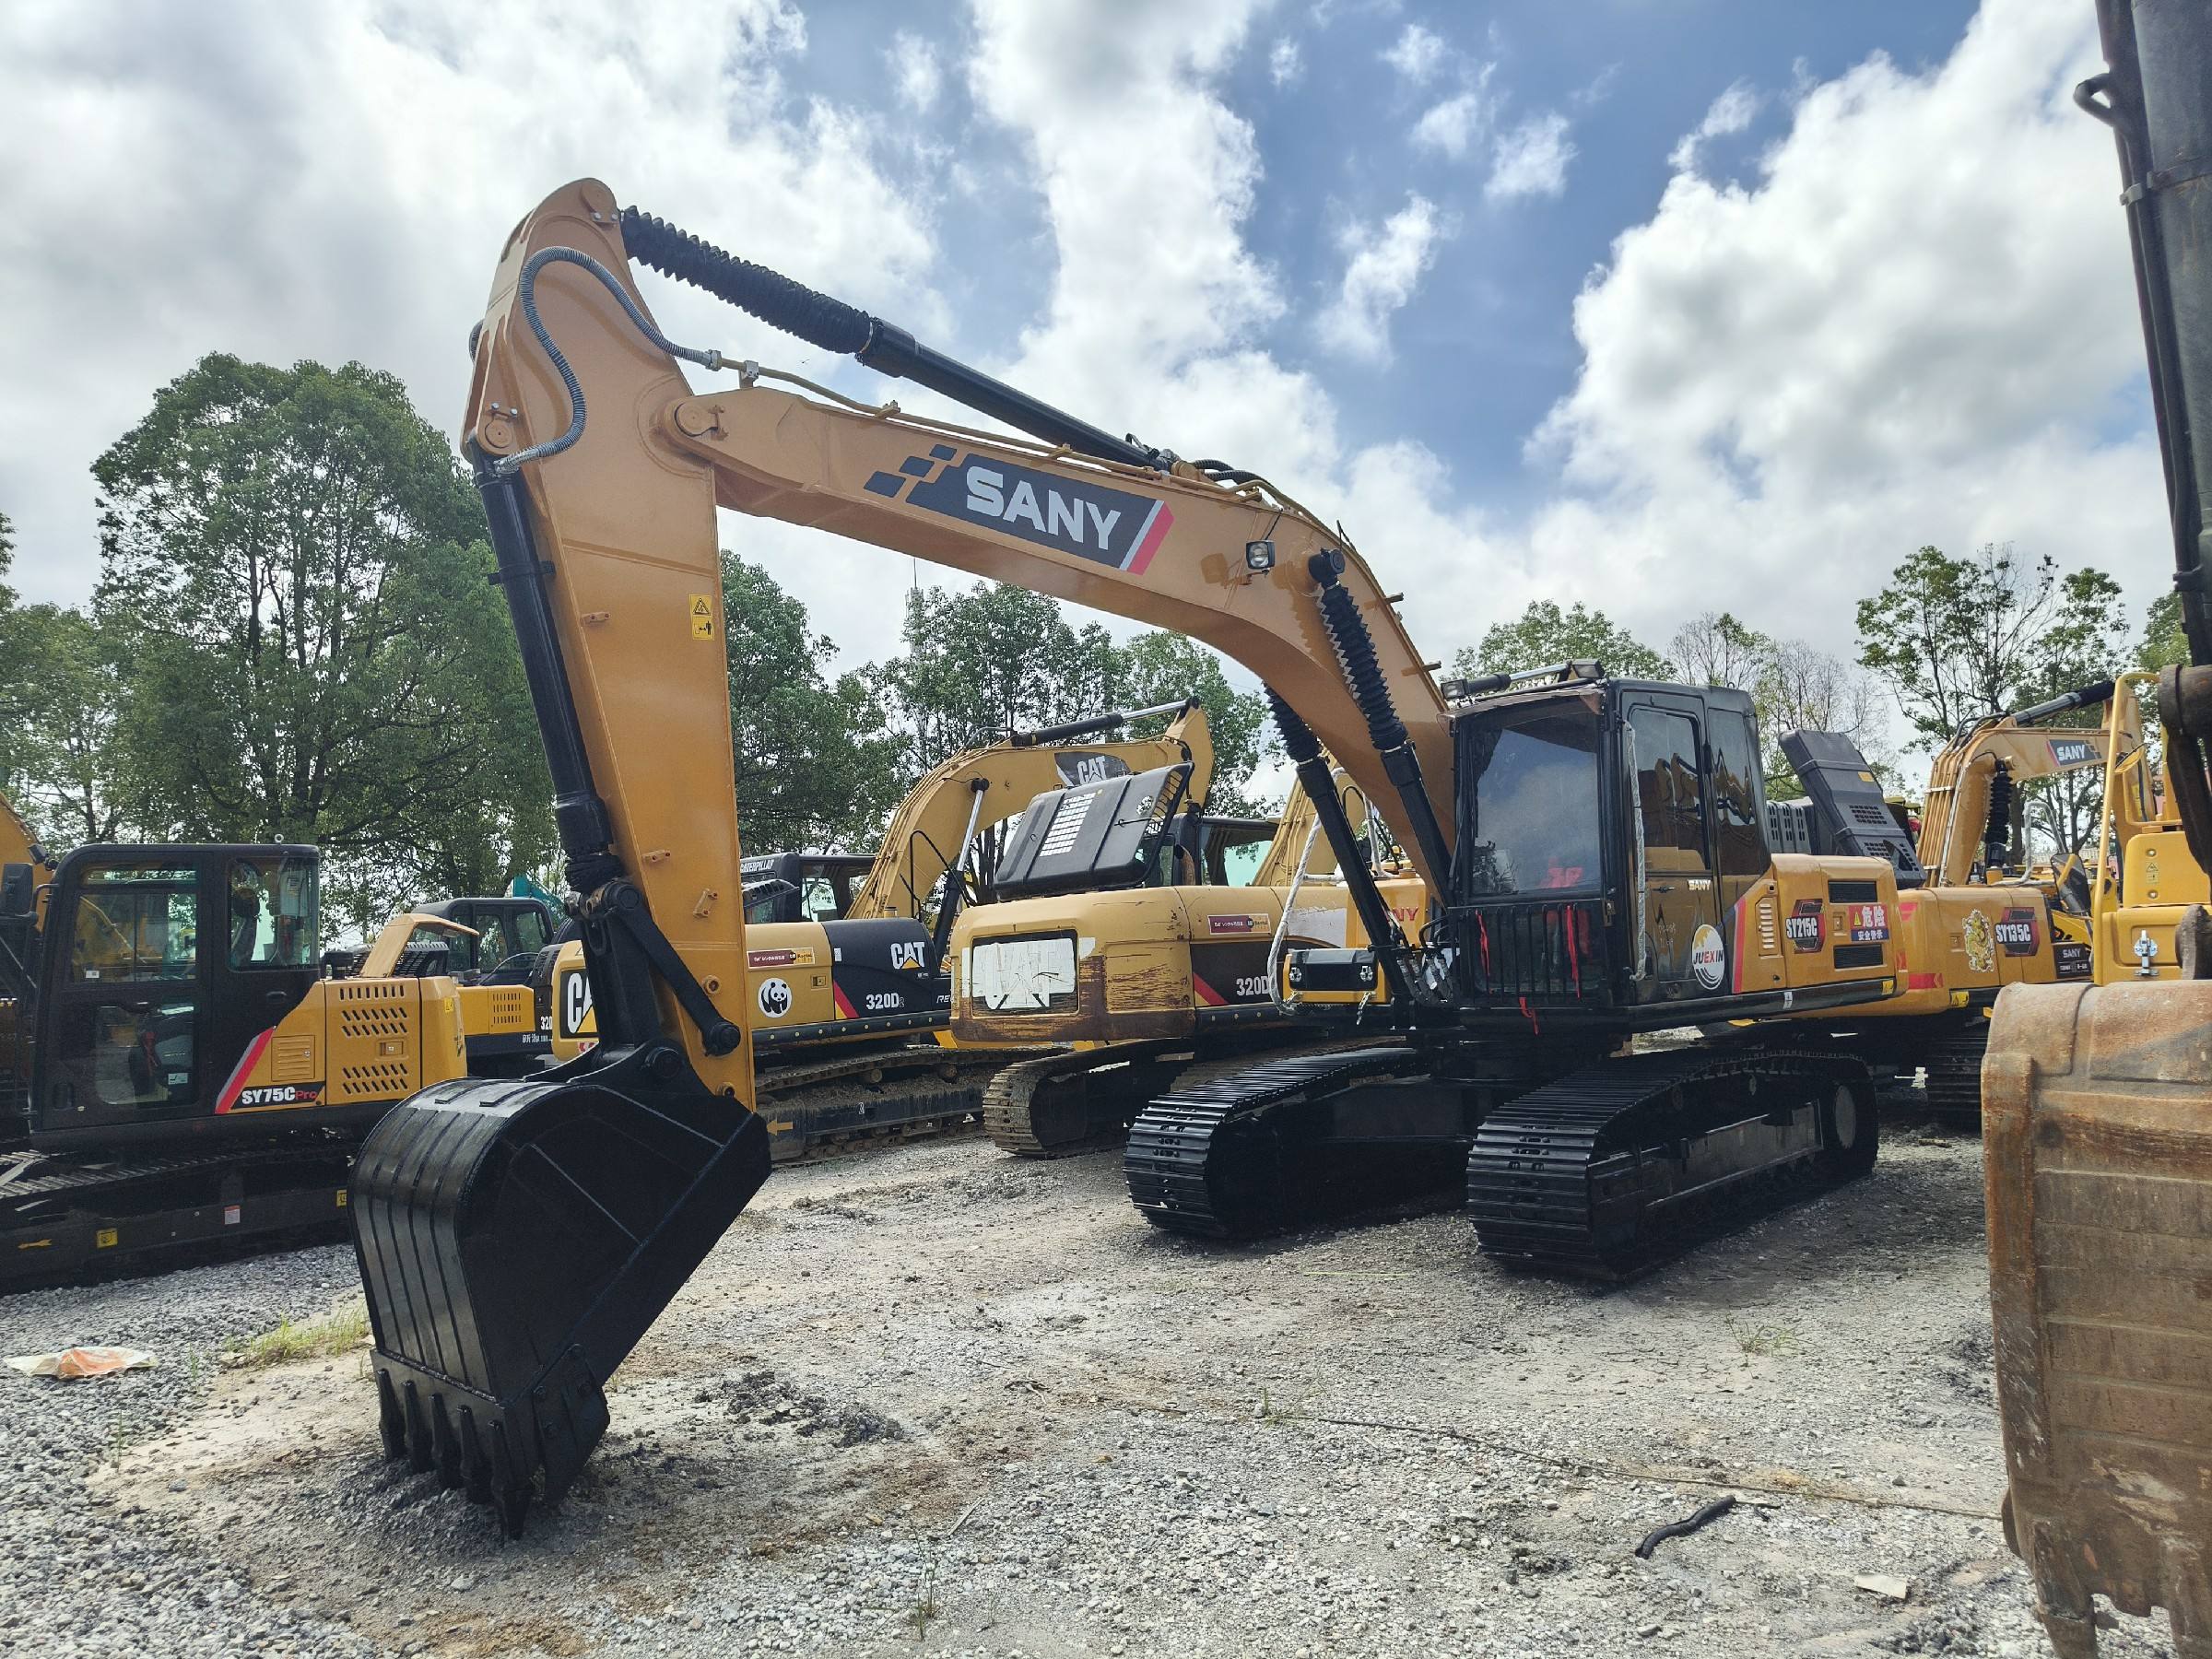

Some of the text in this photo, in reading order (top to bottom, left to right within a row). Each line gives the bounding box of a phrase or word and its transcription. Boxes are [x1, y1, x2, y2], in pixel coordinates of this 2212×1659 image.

[966, 465, 1122, 550] SANY
[2056, 744, 2086, 761] SANY
[1077, 756, 1107, 785] CAT
[1688, 879, 1712, 891] SANY
[1862, 905, 1885, 927] 危险
[1785, 917, 1818, 938] SY215C
[1995, 924, 2031, 943] SY135C
[890, 941, 925, 970] CAT
[1693, 949, 1724, 964] JUEXIN
[2062, 947, 2081, 959] SANY
[241, 1087, 296, 1104] SY75C
